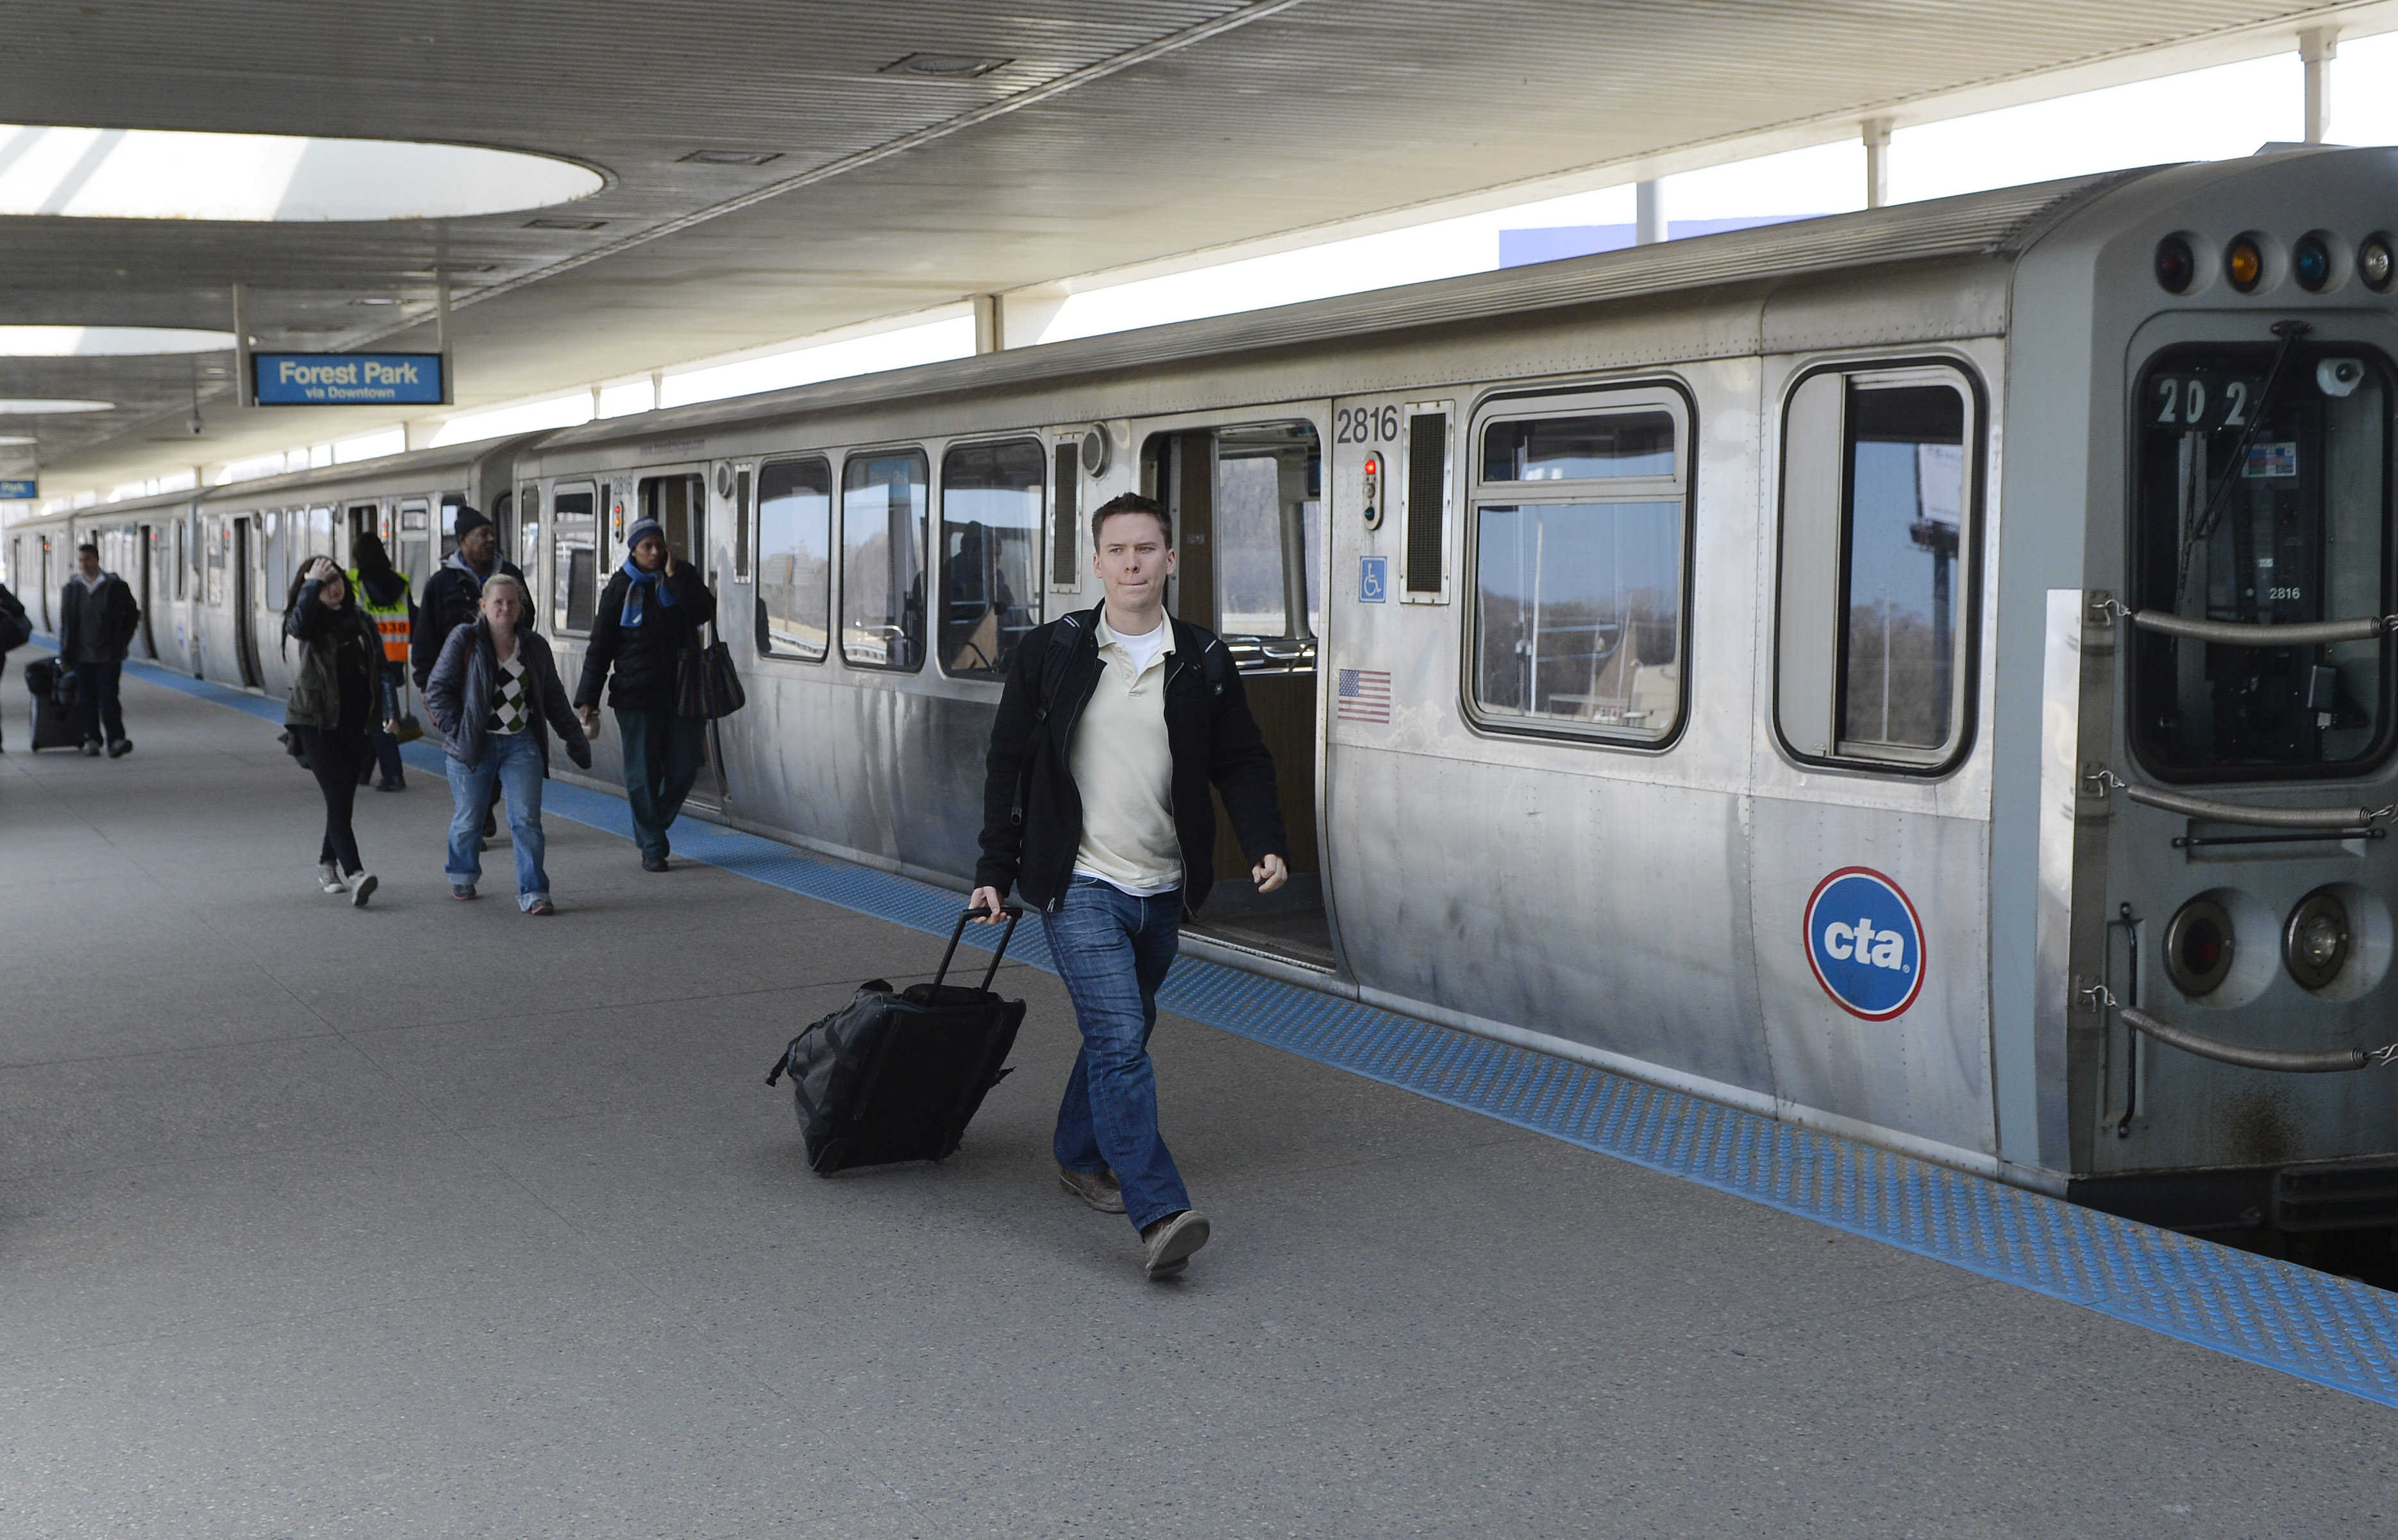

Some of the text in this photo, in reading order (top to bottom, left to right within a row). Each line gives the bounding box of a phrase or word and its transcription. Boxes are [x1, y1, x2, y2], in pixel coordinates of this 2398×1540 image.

[280, 361, 419, 385] Forest Park
[305, 386, 395, 399] via Downtown
[1337, 405, 1397, 444] 2816
[2270, 587, 2301, 599] 2816
